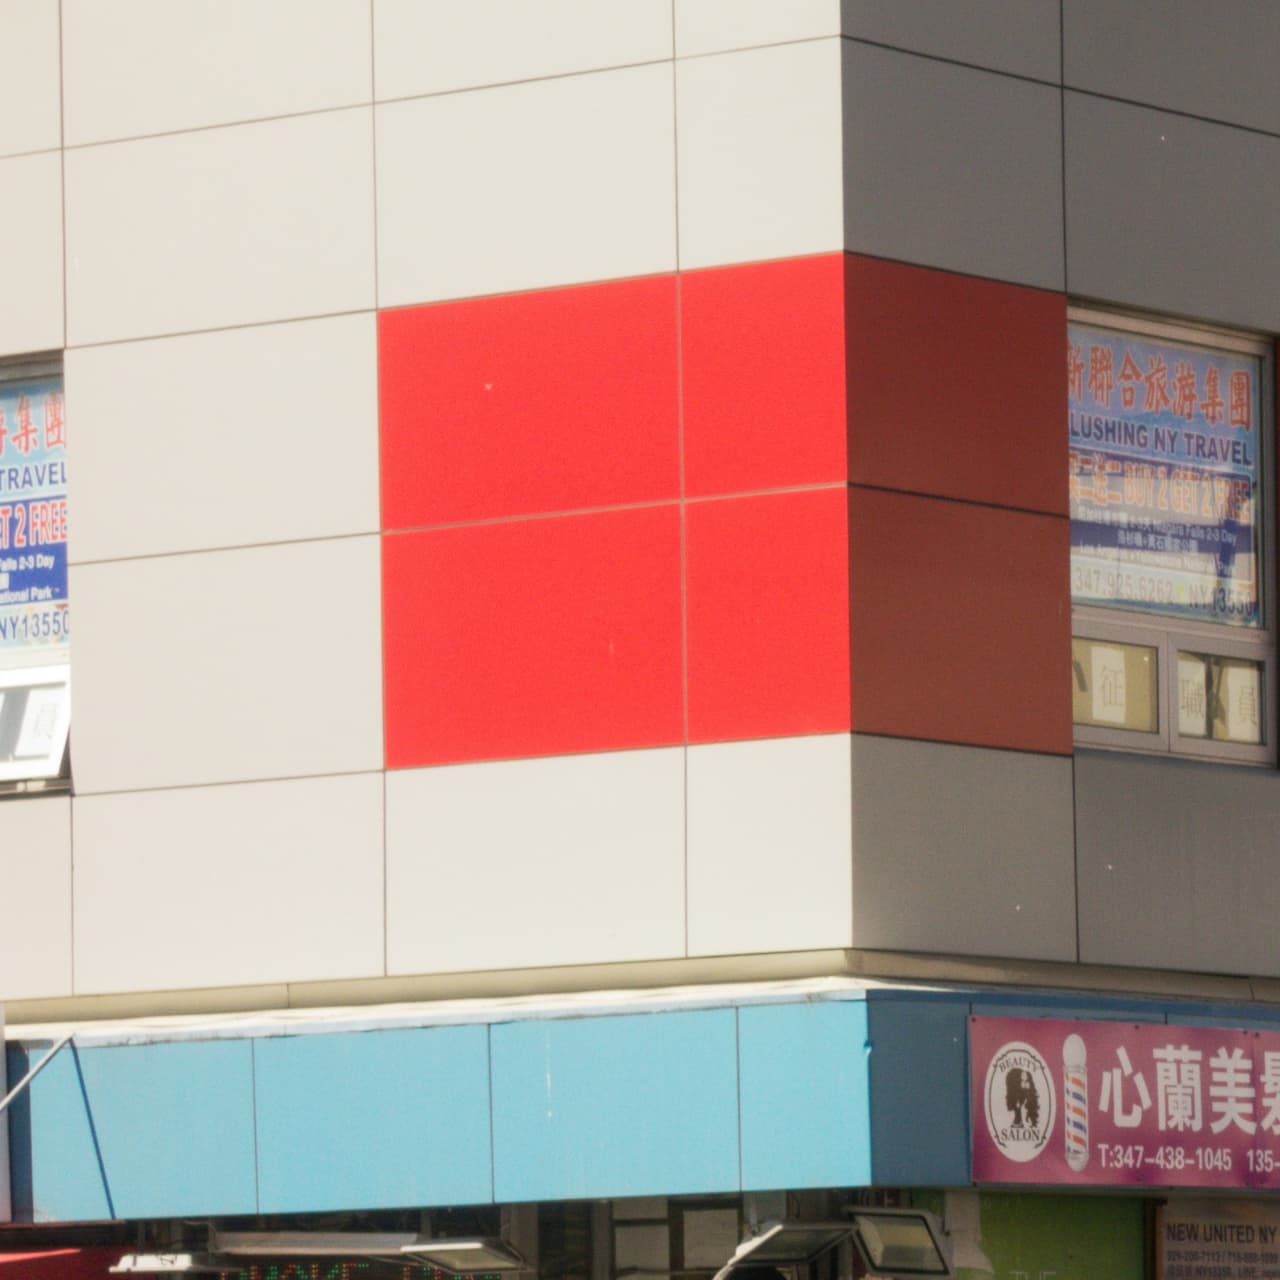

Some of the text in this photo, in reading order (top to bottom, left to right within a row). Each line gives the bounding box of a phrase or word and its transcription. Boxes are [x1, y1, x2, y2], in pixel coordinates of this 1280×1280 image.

[1154, 426, 1178, 454] NY
[1184, 433, 1252, 466] TRAVEL
[1123, 463, 1250, 524] BUY 2 GET 2 FREE
[14, 503, 26, 547] 2
[30, 501, 68, 543] FREE
[998, 1056, 1040, 1073] BEAUTY
[1000, 1129, 1041, 1144] SALON
[1166, 1223, 1198, 1243] NEW
[1203, 1225, 1255, 1245] UNITED
[1259, 1227, 1278, 1245] NY
